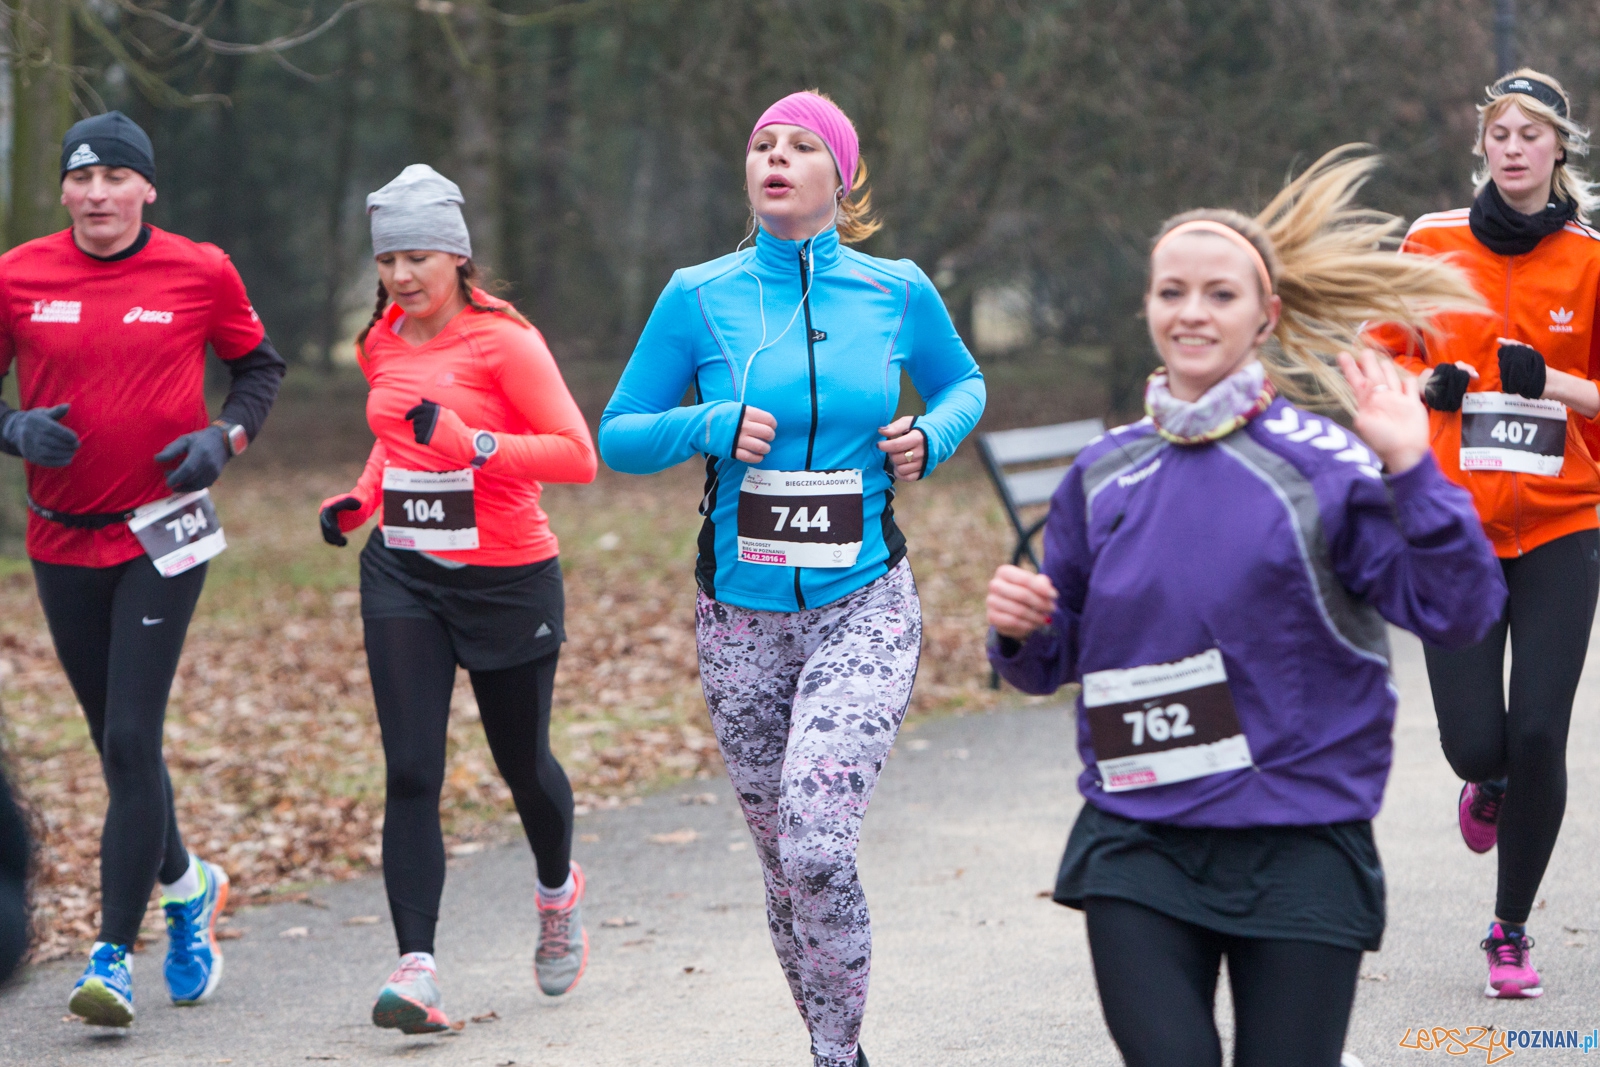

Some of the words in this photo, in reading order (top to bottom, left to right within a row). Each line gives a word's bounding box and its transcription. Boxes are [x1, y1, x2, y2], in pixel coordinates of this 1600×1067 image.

[1548, 324, 1573, 333] adidas
[1490, 420, 1539, 446] 407
[785, 479, 857, 487] BIEGCZEKOLADOWY.PL
[402, 498, 446, 523] 104
[770, 506, 830, 532] 744
[165, 507, 208, 543] 794
[743, 552, 779, 562] 14.02.2016
[1122, 702, 1196, 746] 762
